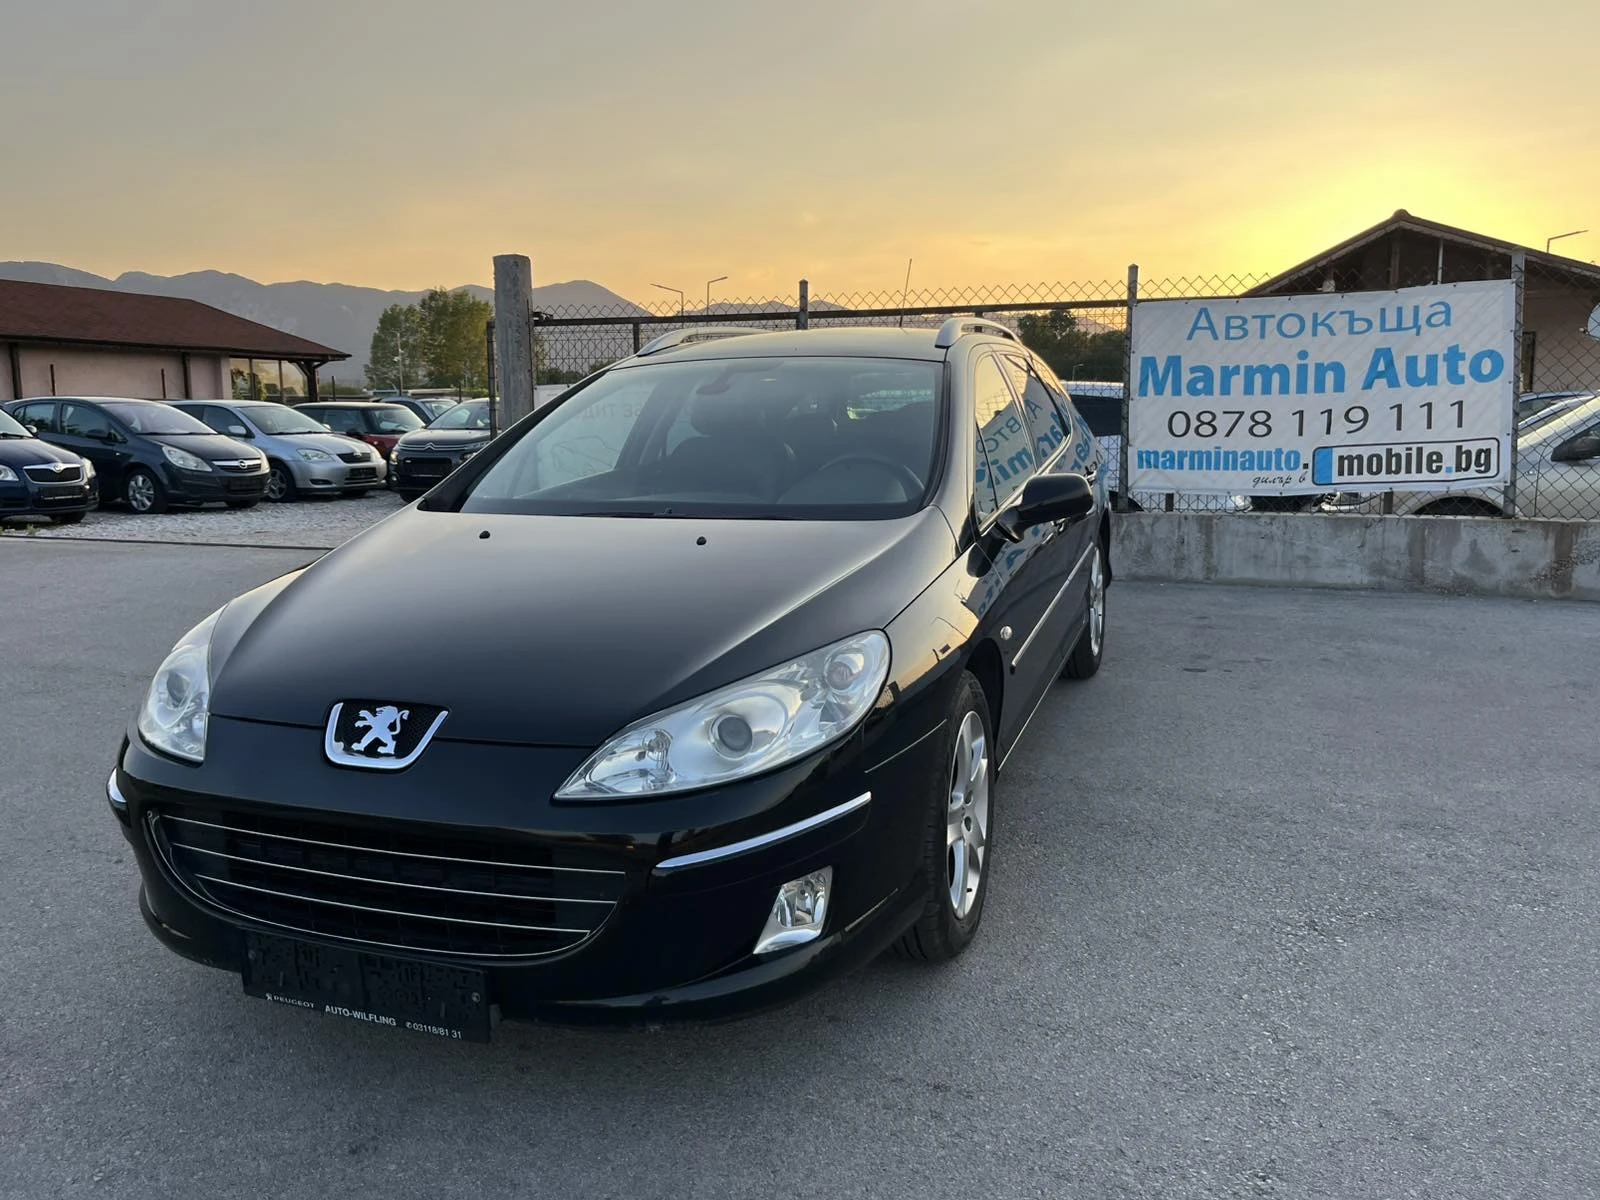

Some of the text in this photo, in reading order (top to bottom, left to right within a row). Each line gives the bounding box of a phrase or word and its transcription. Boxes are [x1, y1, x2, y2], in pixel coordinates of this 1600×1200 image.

[1186, 300, 1452, 341] Автокъща
[1138, 343, 1504, 398] Marmin Auto
[1167, 399, 1465, 439] 0878 119 111
[1338, 445, 1492, 477] mobile.bg
[325, 1005, 396, 1026] AUTO-WILFLING
[451, 1029, 462, 1039] 31
